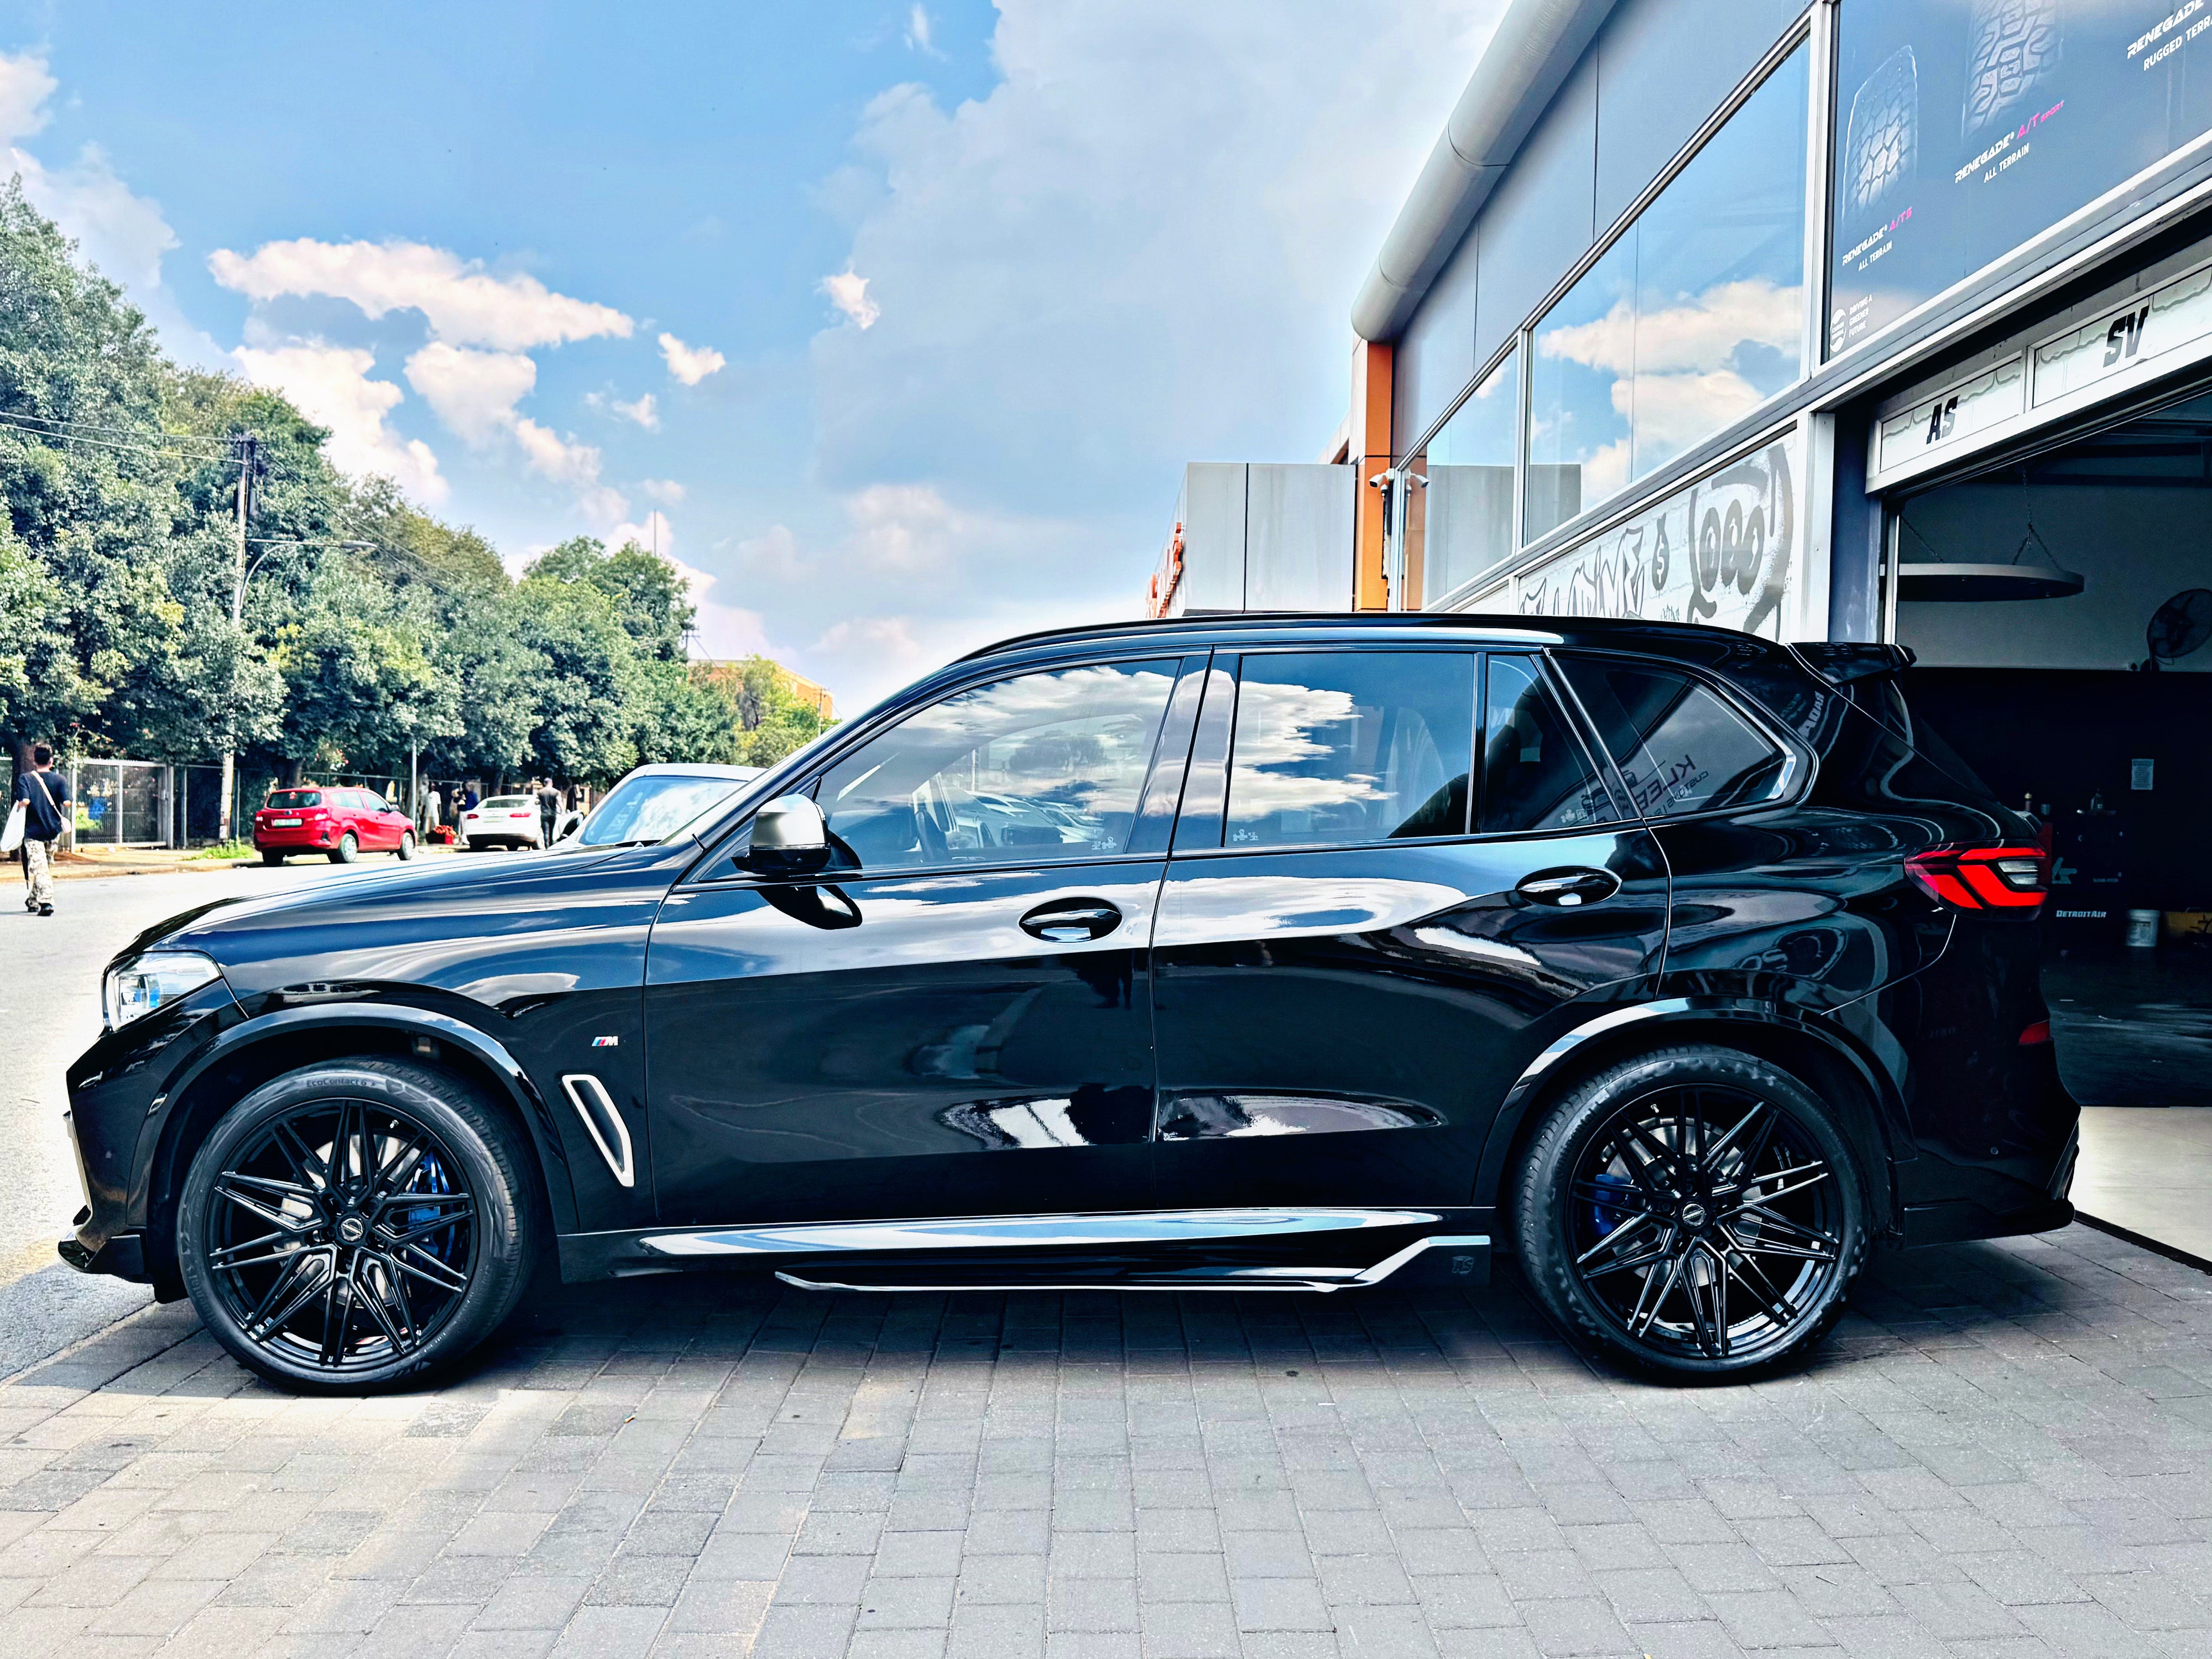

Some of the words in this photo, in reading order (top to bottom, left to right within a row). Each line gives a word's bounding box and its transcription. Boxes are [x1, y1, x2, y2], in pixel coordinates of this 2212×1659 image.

[2127, 0, 2204, 59] RENEGADE
[2143, 35, 2183, 71] RUGGED
[2185, 15, 2212, 41] TERR
[1955, 133, 2011, 184] RENEGADE
[1984, 167, 1997, 183] ALL
[1999, 143, 2030, 172] TERRAIN
[1842, 226, 1885, 266] RENEGADE
[1858, 258, 1869, 272] ALL
[1870, 240, 1892, 263] TERRAIN
[1849, 296, 1868, 315] DRIVING
[1869, 294, 1872, 302] A
[1849, 307, 1869, 326] GREENER
[1849, 320, 1866, 338] FUTURE
[2103, 305, 2150, 368] SV
[1926, 394, 1960, 445] AS
[306, 1078, 359, 1088] EcoContact
